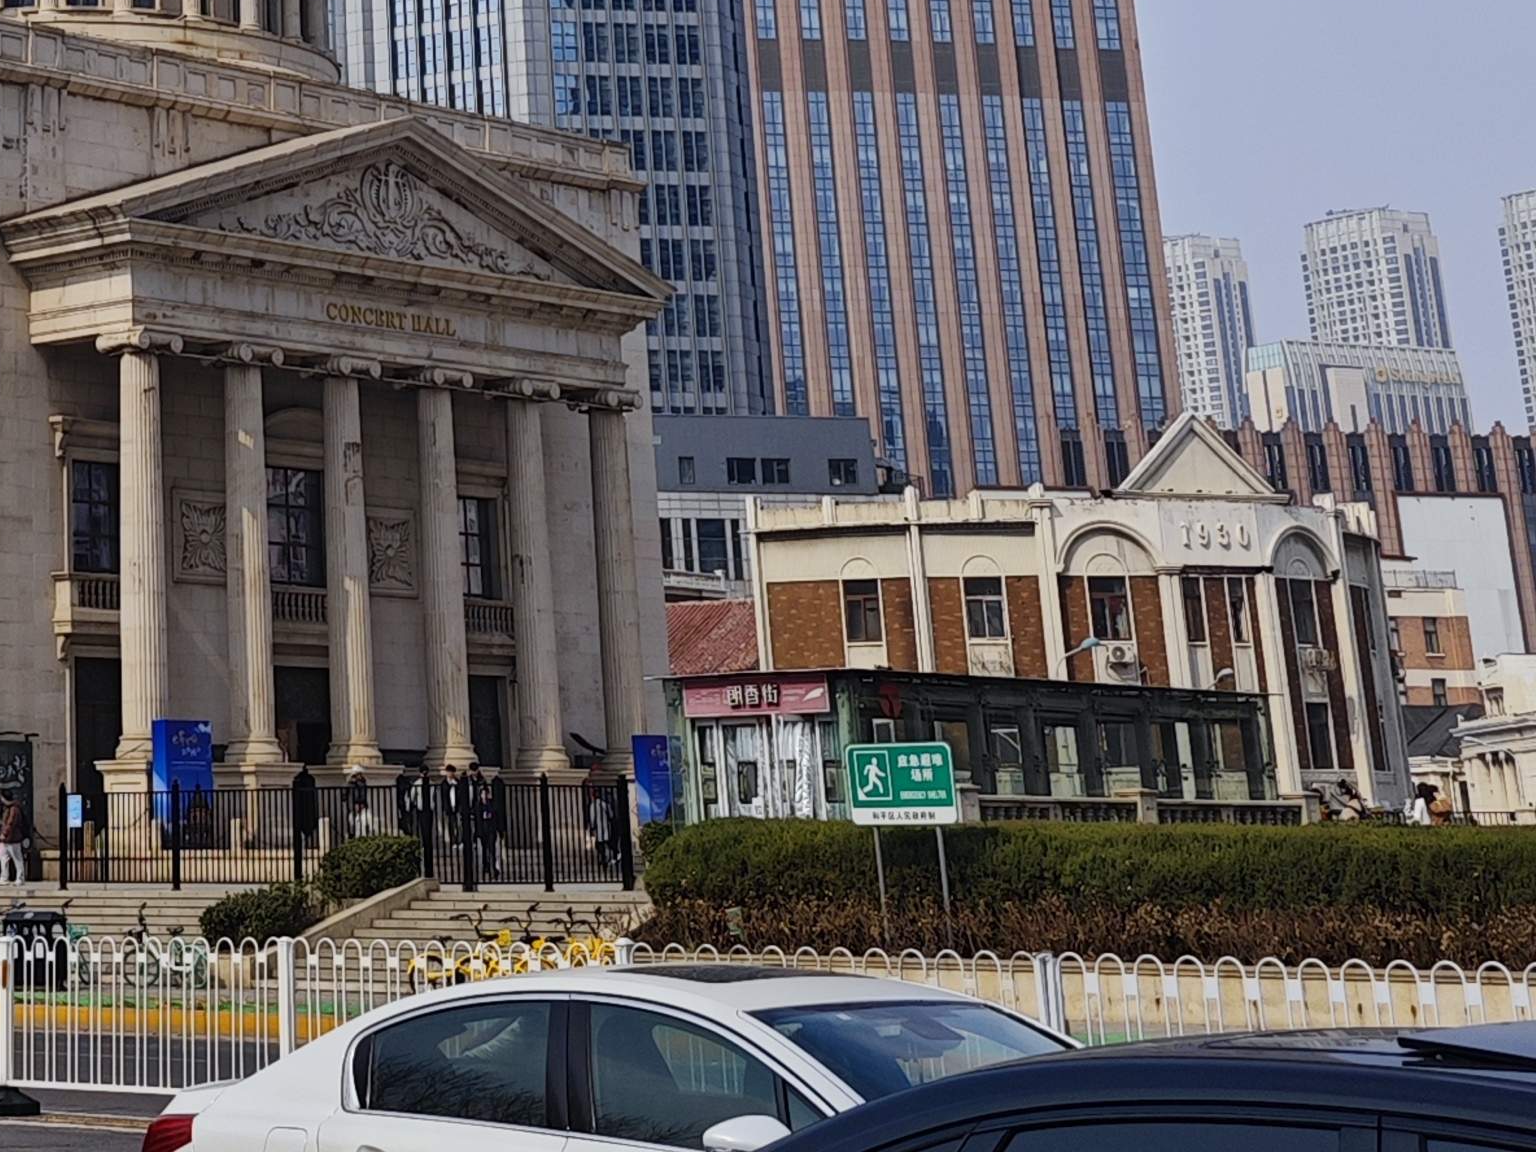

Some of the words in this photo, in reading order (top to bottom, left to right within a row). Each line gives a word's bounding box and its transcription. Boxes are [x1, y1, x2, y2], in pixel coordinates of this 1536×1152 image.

[326, 301, 407, 332] CONCERT
[410, 312, 457, 338] HALL
[1179, 521, 1251, 551] 1930
[897, 752, 944, 768] 应急避难
[910, 768, 934, 782] 场所
